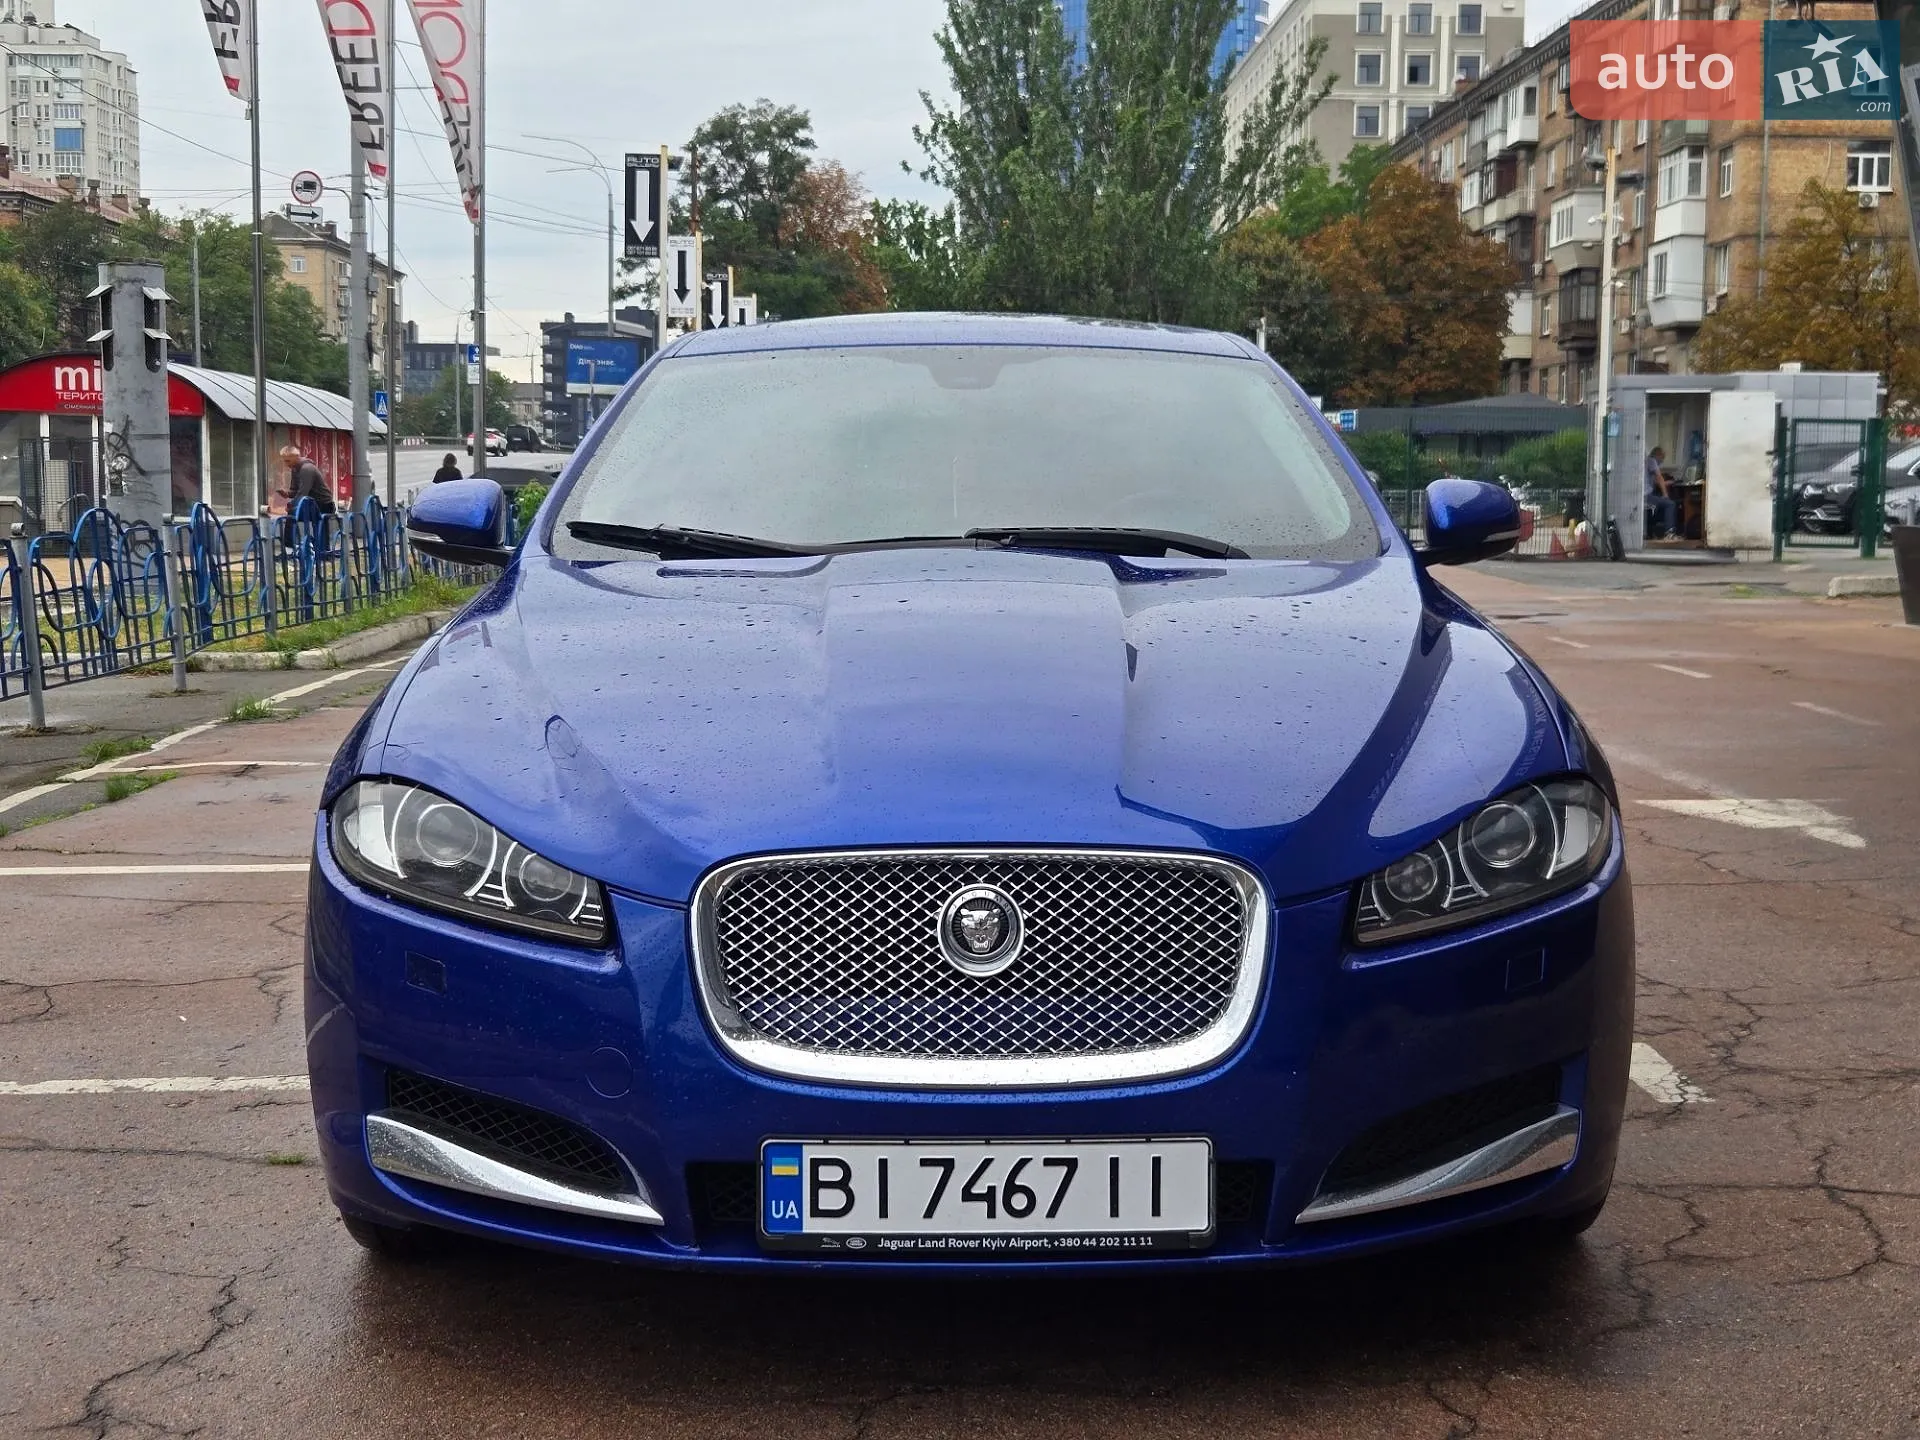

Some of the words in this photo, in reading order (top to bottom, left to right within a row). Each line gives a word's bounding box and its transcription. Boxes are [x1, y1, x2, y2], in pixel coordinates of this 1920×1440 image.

[55, 360, 103, 391] mi
[919, 1156, 1079, 1219] 7467
[772, 1200, 799, 1219] UA
[878, 1237, 916, 1250] Jaguar
[918, 1238, 946, 1248] Land
[948, 1238, 980, 1248] Rover
[982, 1238, 1006, 1250] Kyiv
[1009, 1237, 1051, 1250] Airport,
[1053, 1237, 1081, 1247] +380
[1082, 1237, 1097, 1247] 44
[1099, 1237, 1120, 1247] 202
[1123, 1237, 1137, 1246] 11
[1140, 1237, 1153, 1246] 11
